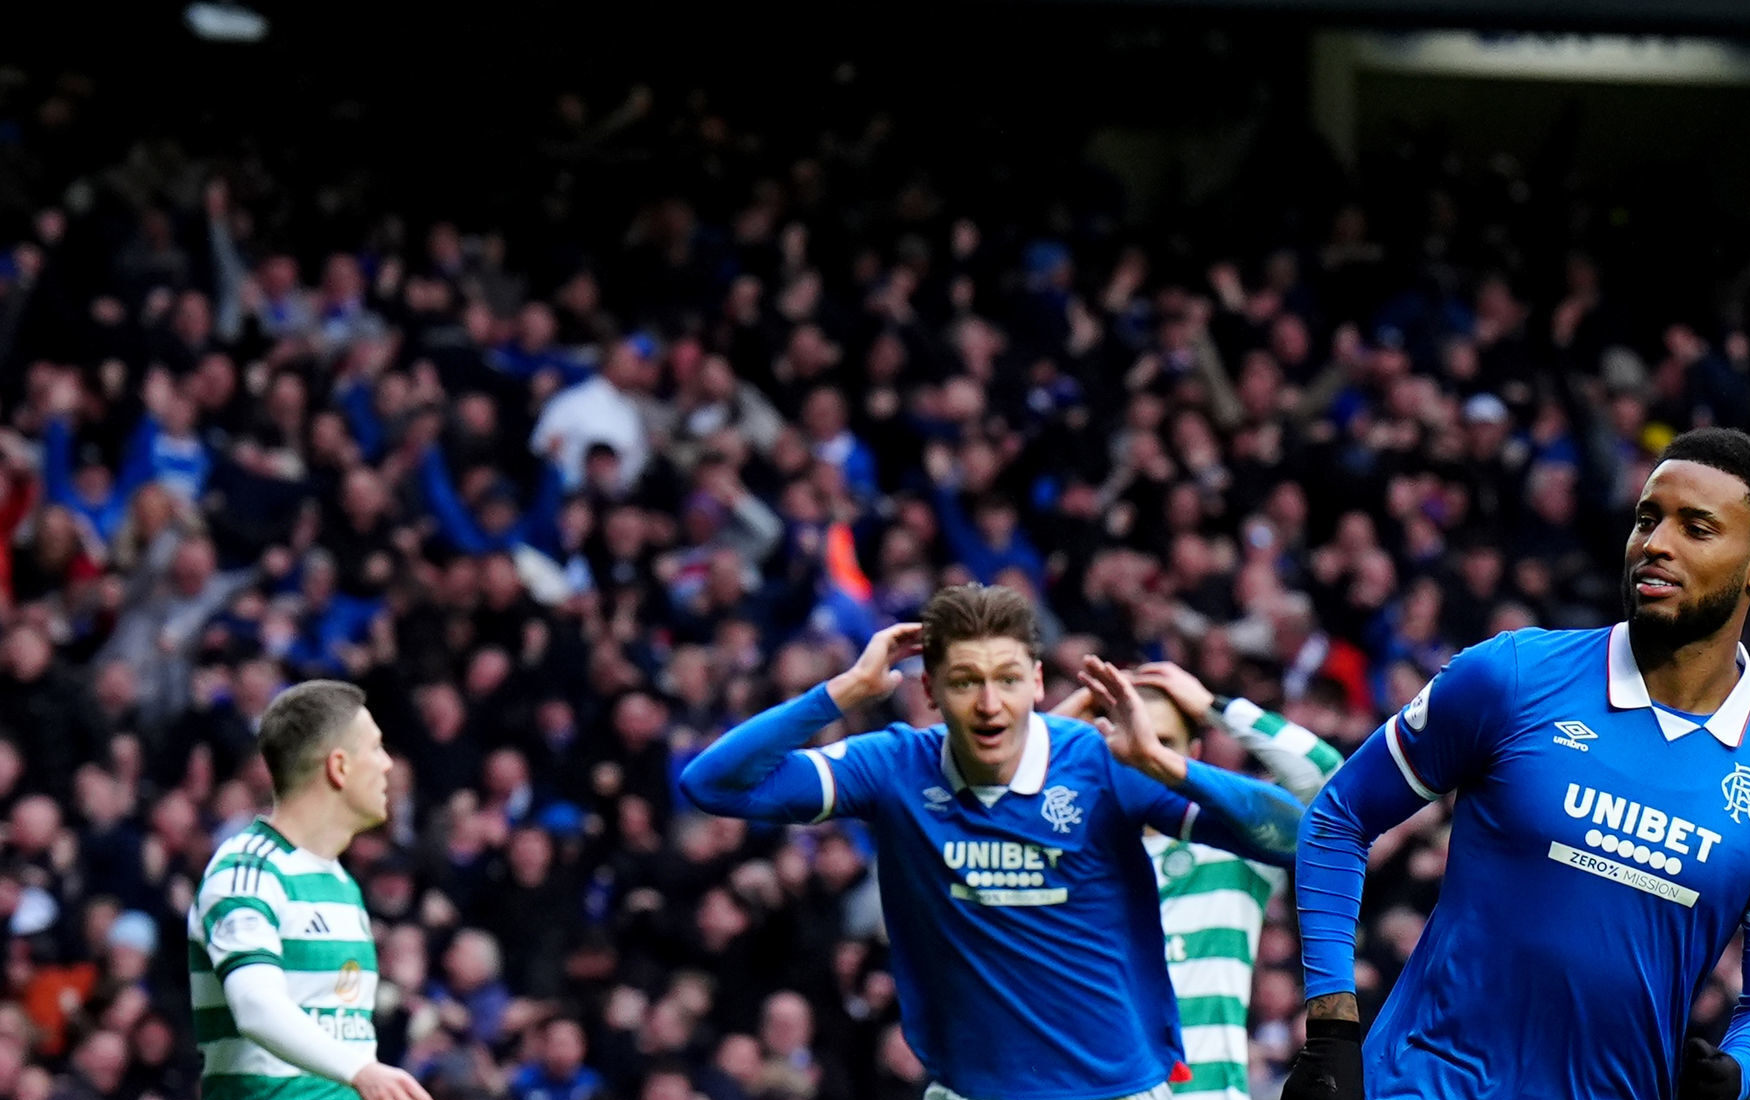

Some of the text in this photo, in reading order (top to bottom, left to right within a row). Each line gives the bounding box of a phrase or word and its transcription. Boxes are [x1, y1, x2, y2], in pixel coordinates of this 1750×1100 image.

[1553, 735, 1589, 752] umbro
[1563, 782, 1722, 863] UNIBET
[943, 841, 1063, 870] UNIBET
[1569, 851, 1680, 899] ZERO% MISSION
